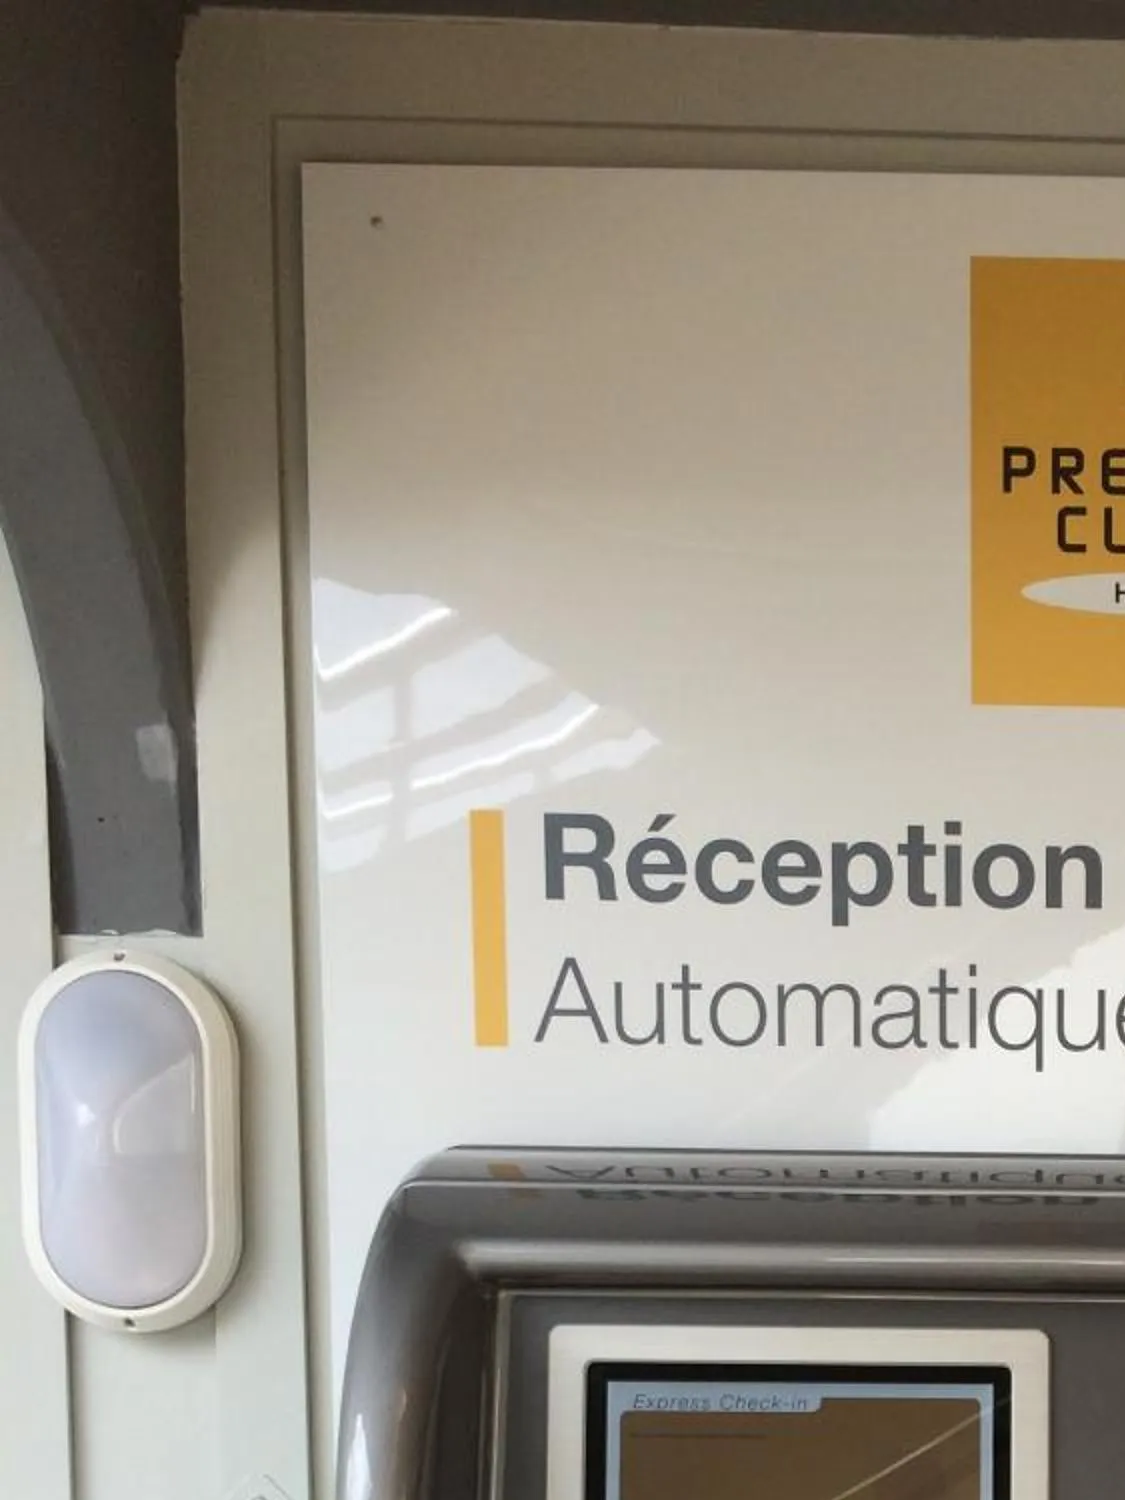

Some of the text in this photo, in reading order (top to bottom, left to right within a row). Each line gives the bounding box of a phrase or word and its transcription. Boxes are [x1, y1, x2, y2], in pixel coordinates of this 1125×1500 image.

[543, 811, 1103, 928] Réception
[632, 1393, 808, 1411] Express Check-in
